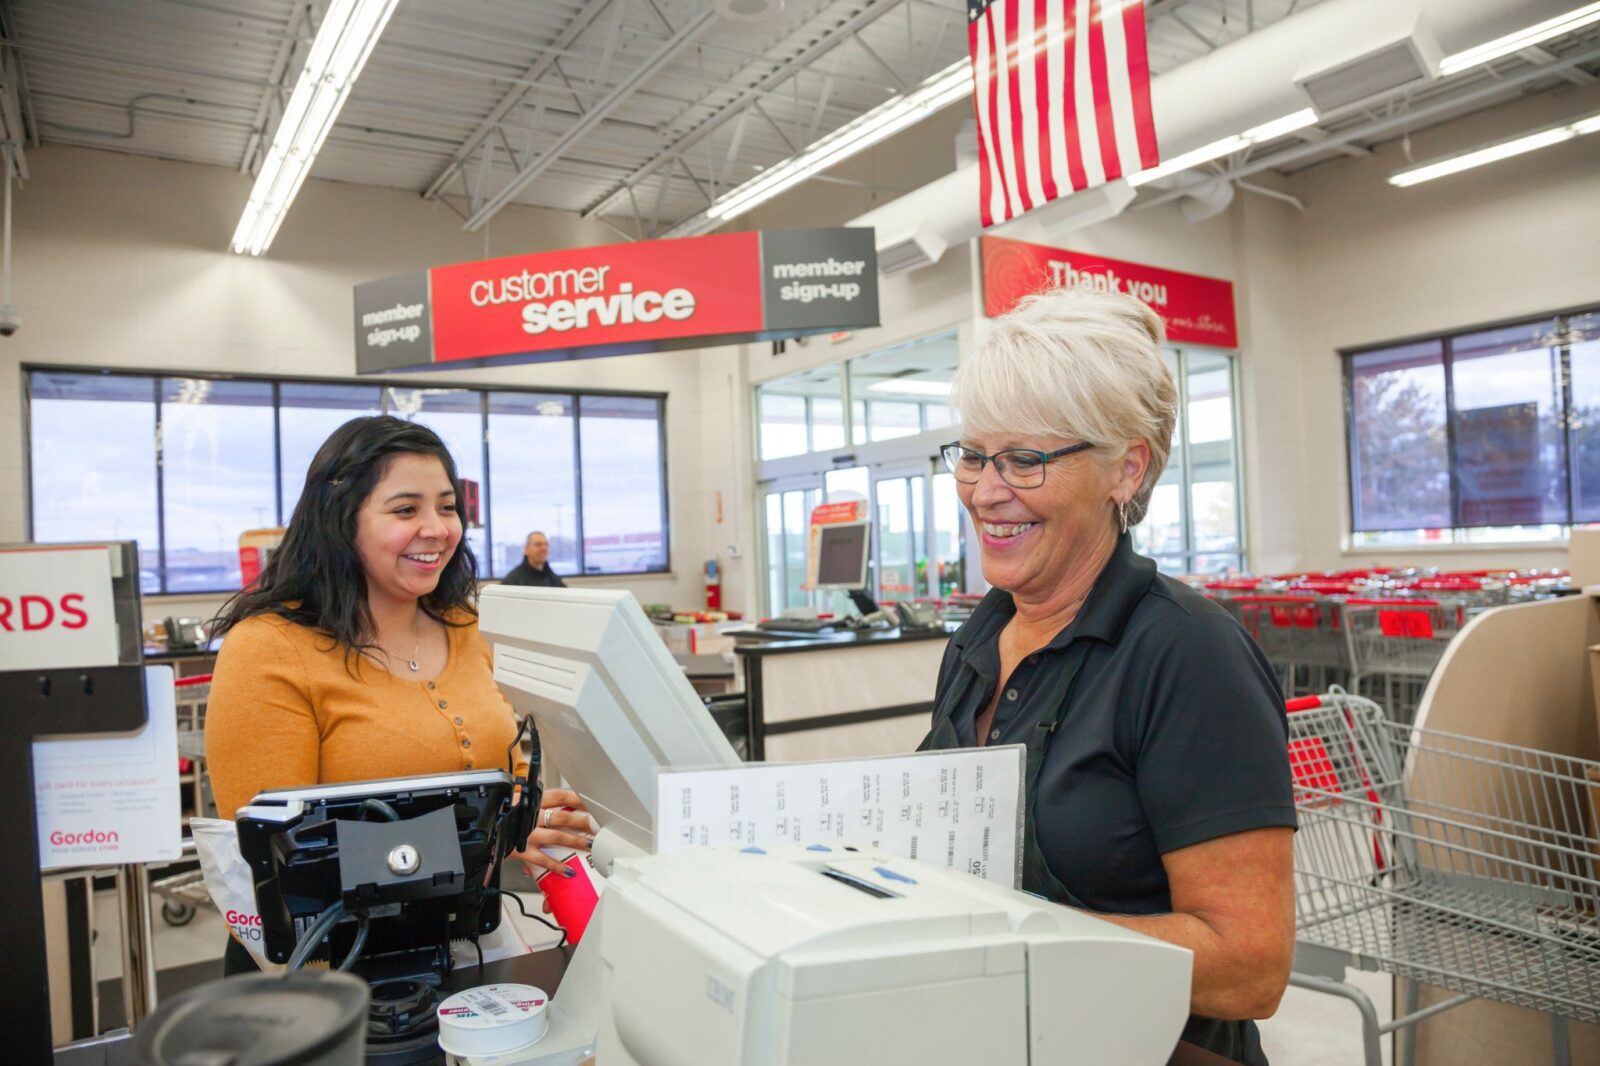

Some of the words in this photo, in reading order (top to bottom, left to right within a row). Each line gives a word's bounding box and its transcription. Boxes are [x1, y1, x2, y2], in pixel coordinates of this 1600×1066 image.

[773, 257, 865, 279] member
[470, 264, 611, 307] customer
[780, 281, 861, 303] sign-up
[1047, 259, 1121, 295] Thank
[1126, 278, 1168, 306] you
[362, 303, 424, 327] member
[522, 282, 696, 334] service
[367, 324, 421, 347] sign-up
[0, 593, 89, 632] RDS
[50, 829, 119, 847] Gordon
